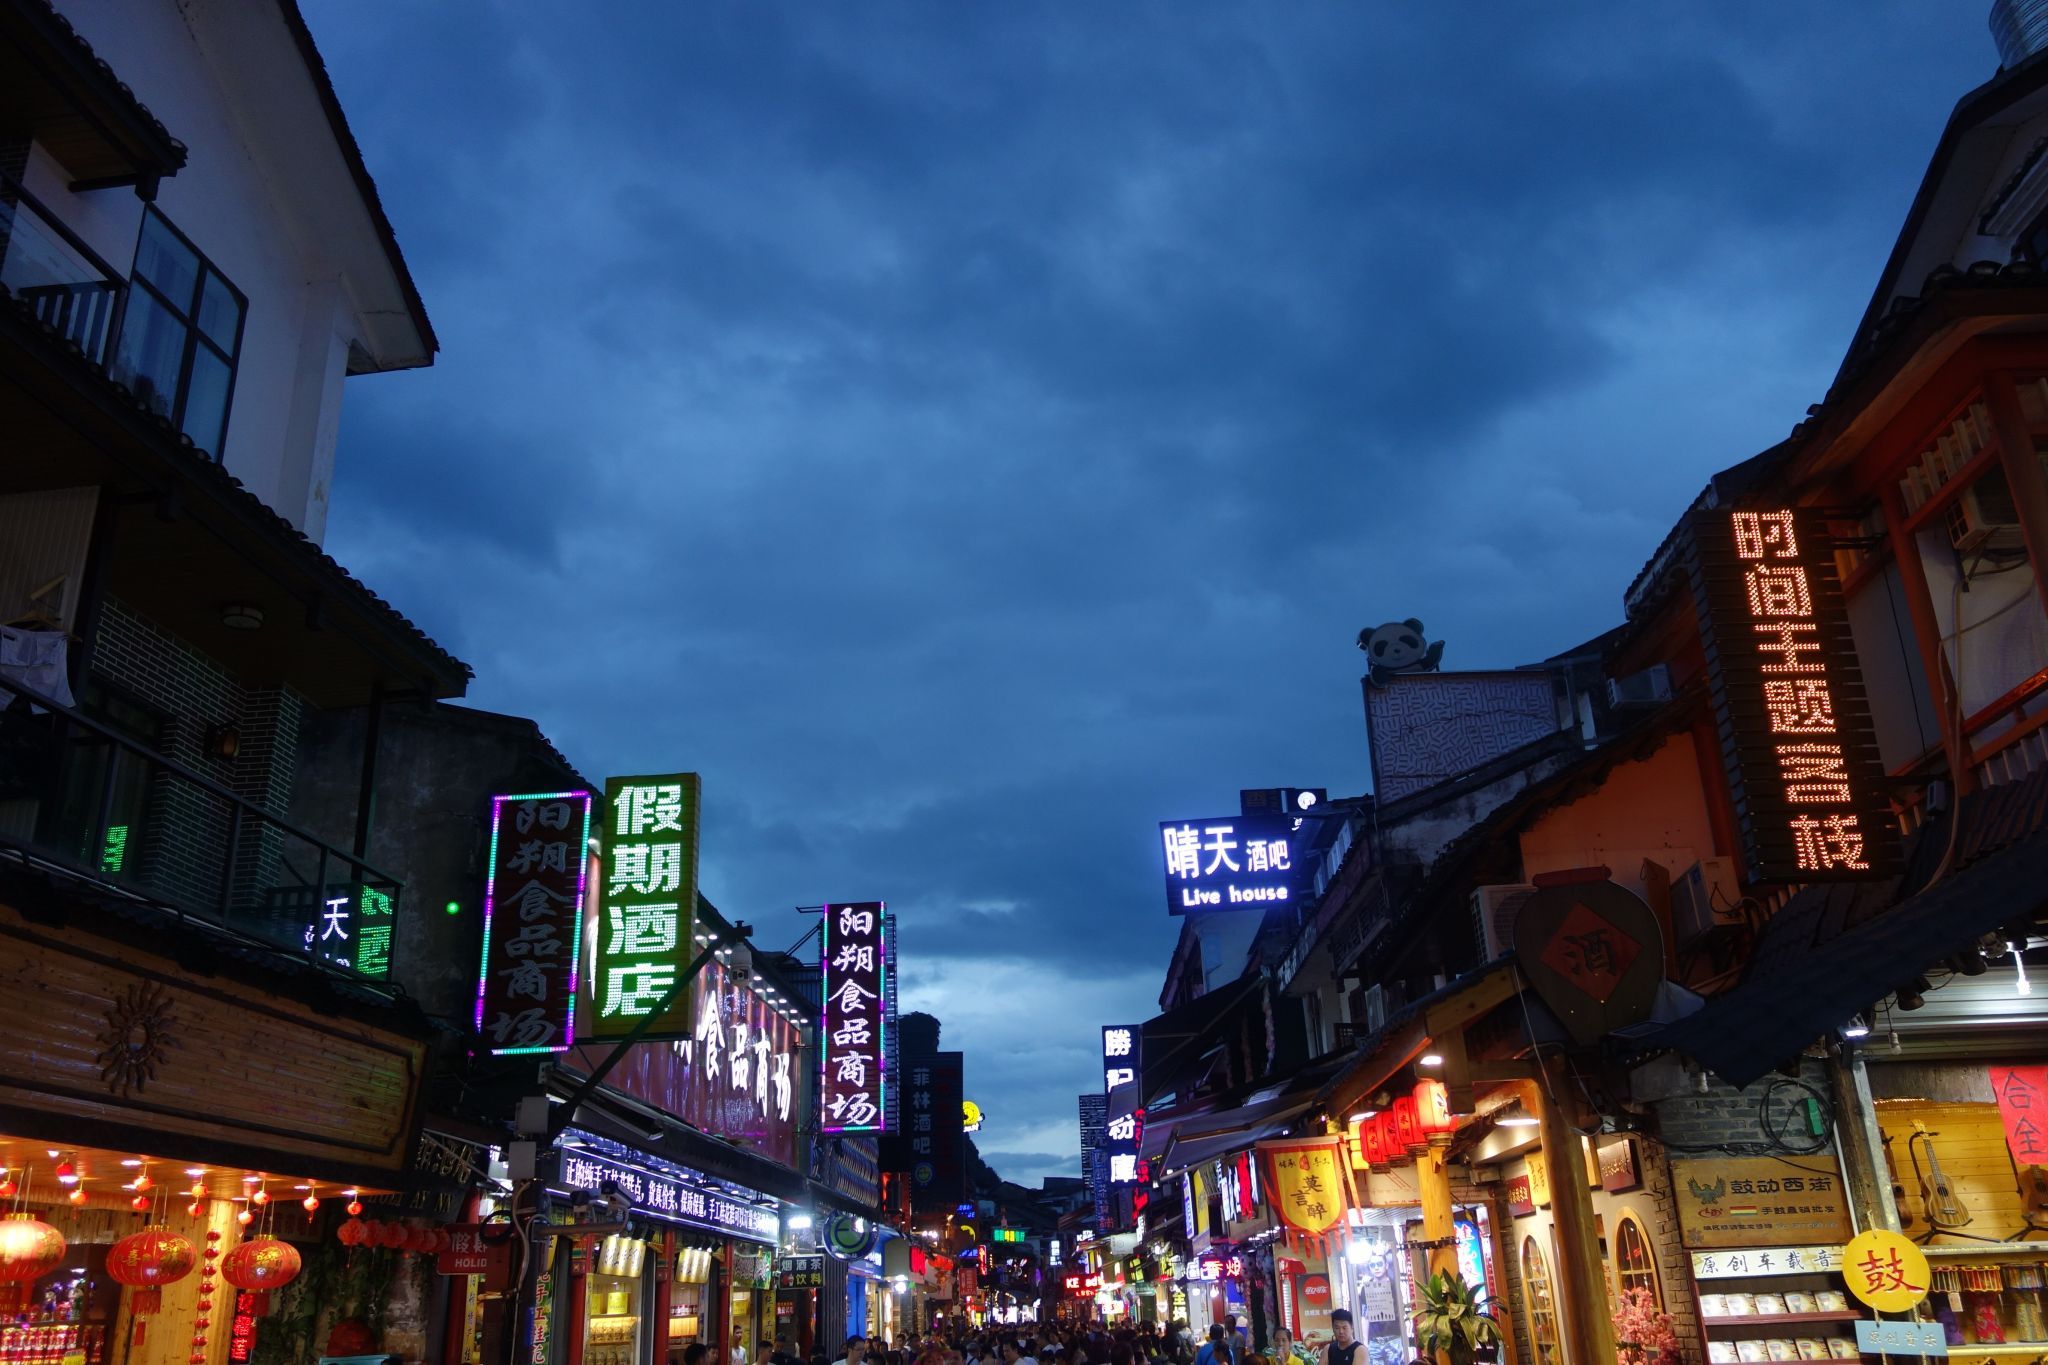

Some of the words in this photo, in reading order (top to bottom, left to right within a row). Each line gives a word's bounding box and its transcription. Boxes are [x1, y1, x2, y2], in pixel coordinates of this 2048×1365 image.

[1731, 509, 1869, 871] 时间主题客栈
[486, 800, 574, 1046] 阳朔食品商场
[601, 783, 682, 1018] 假期酒店
[1183, 887, 1220, 907] Live
[1229, 884, 1289, 904] house
[828, 906, 878, 1126] 阳朔食品商场
[912, 1067, 932, 1155] 菲林酒吧
[1290, 1175, 1328, 1222] 莫言醉
[1730, 1177, 1833, 1195] 鼓动西街
[1701, 1249, 1833, 1275] 原创车载音
[1857, 1247, 1925, 1295] 鼓
